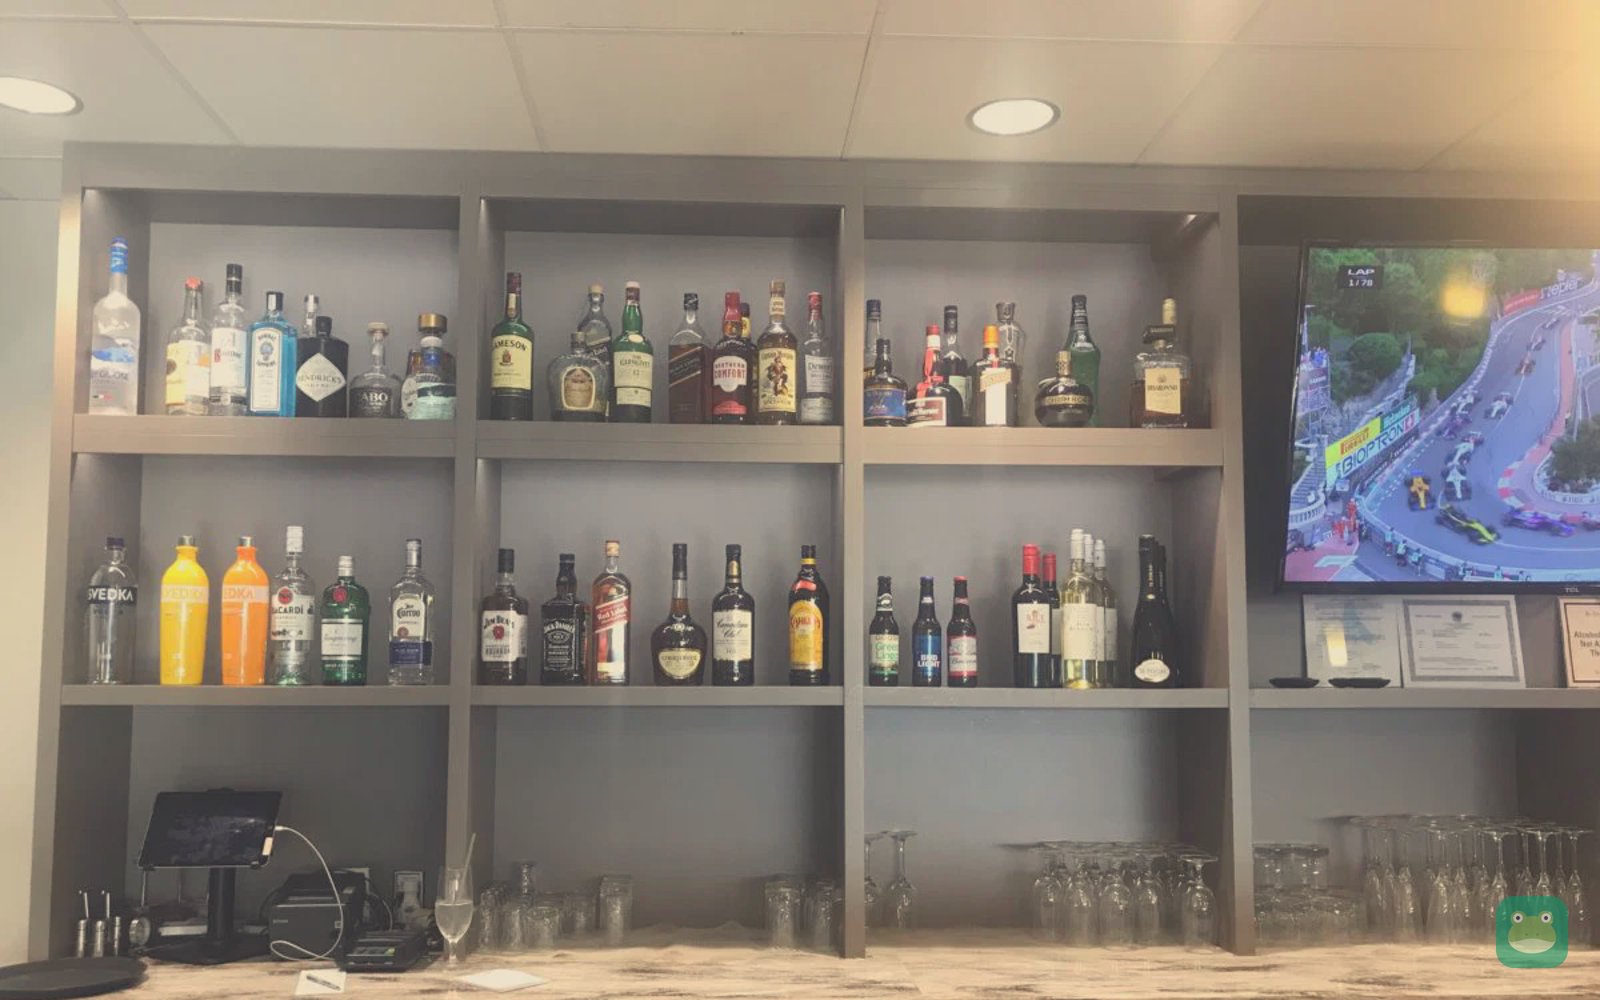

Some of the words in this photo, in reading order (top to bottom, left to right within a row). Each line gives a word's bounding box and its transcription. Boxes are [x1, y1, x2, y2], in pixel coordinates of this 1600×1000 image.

[1347, 268, 1376, 276] LAP
[715, 369, 745, 379] COMFORT
[1342, 424, 1404, 475] BIOPTRON
[87, 587, 134, 602] SVEDKA
